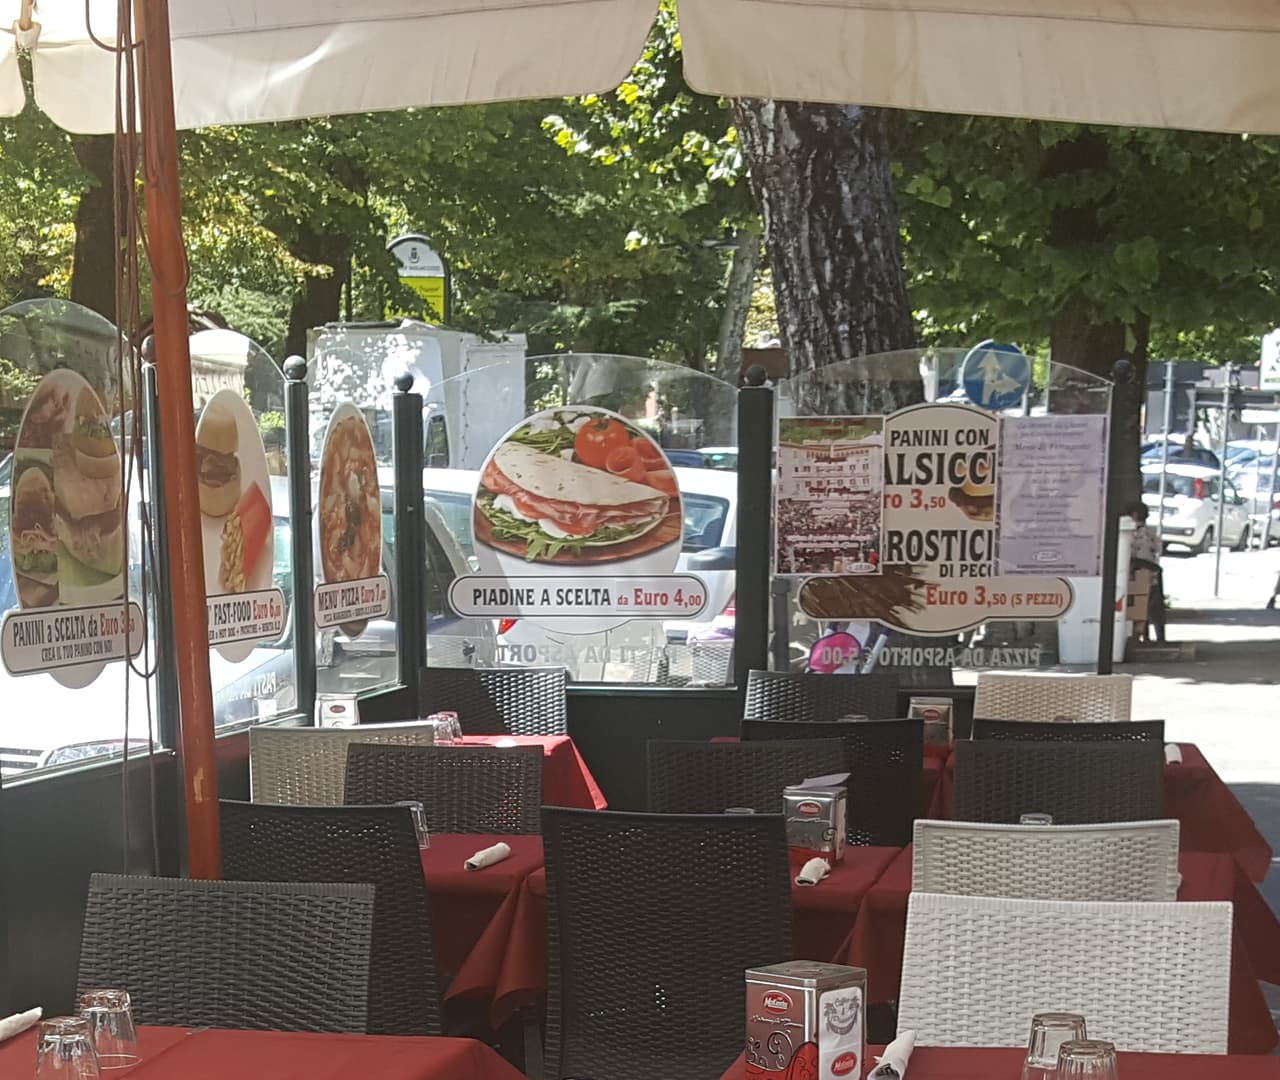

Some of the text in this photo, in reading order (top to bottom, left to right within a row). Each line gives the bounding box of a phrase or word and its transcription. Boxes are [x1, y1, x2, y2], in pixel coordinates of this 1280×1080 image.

[891, 429, 990, 447] PANINI CON
[910, 488, 946, 512] 3,50
[939, 564, 953, 578] DI
[341, 587, 360, 608] PIZZA
[361, 585, 375, 603] Euro
[473, 588, 702, 608] PIADINE A SCELTA da Euro 4,00
[926, 585, 1063, 609] Euro 3,50 (5 PEZZI)
[214, 600, 251, 625] FAST-FOOD
[253, 600, 267, 620] Euro
[13, 620, 44, 647] PANINI
[47, 623, 52, 643] a
[55, 615, 86, 642] SCELTA
[88, 614, 98, 637] da
[100, 613, 118, 636] Euro
[63, 645, 73, 660] TUO
